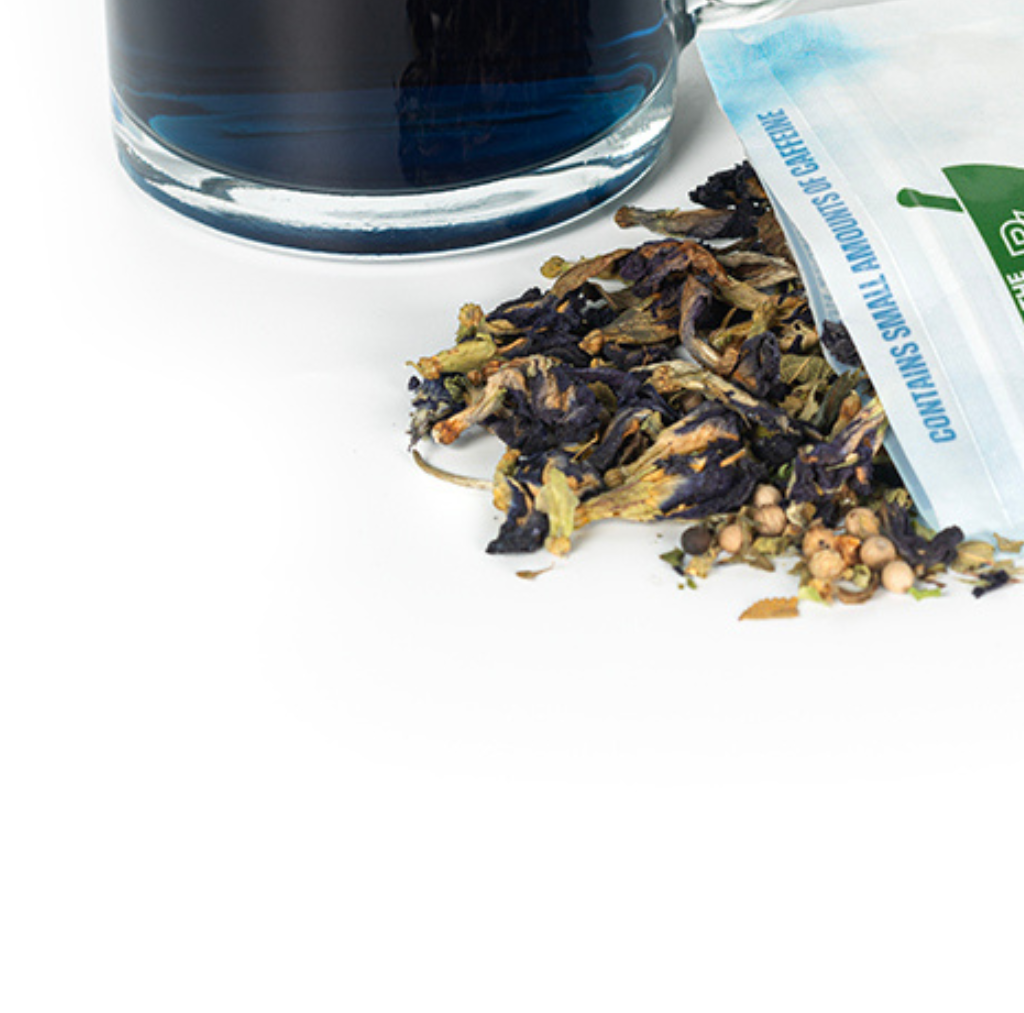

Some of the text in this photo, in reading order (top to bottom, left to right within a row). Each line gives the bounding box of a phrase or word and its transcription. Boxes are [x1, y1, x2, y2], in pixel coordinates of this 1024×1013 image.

[757, 107, 957, 443] CONTAINS SMALL AMOUNTS OF CAFFEINE
